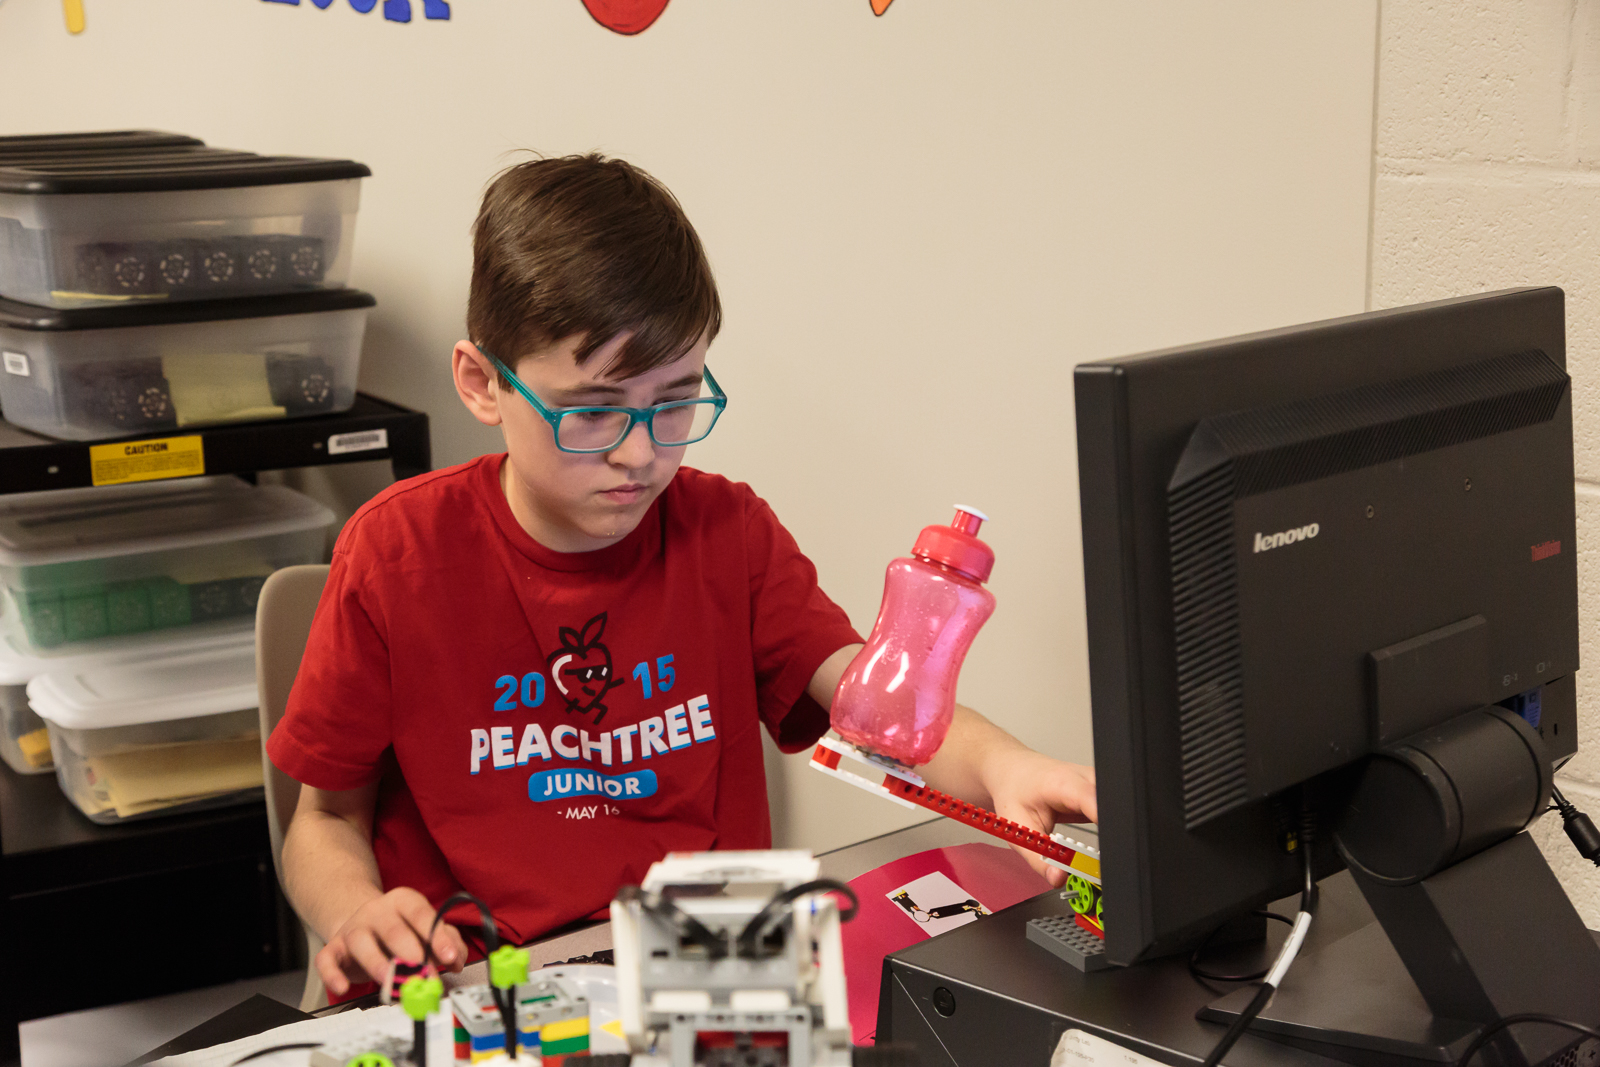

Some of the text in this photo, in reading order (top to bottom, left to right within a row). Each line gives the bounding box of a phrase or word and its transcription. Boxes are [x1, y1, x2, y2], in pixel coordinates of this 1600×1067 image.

[124, 442, 168, 455] CAUTION
[1253, 522, 1320, 553] lenovo
[493, 653, 676, 712] 20 15
[469, 693, 717, 776] PEACHTREE
[543, 772, 642, 798] JUNIOR
[565, 804, 599, 820] MAY
[603, 803, 621, 816] 16
